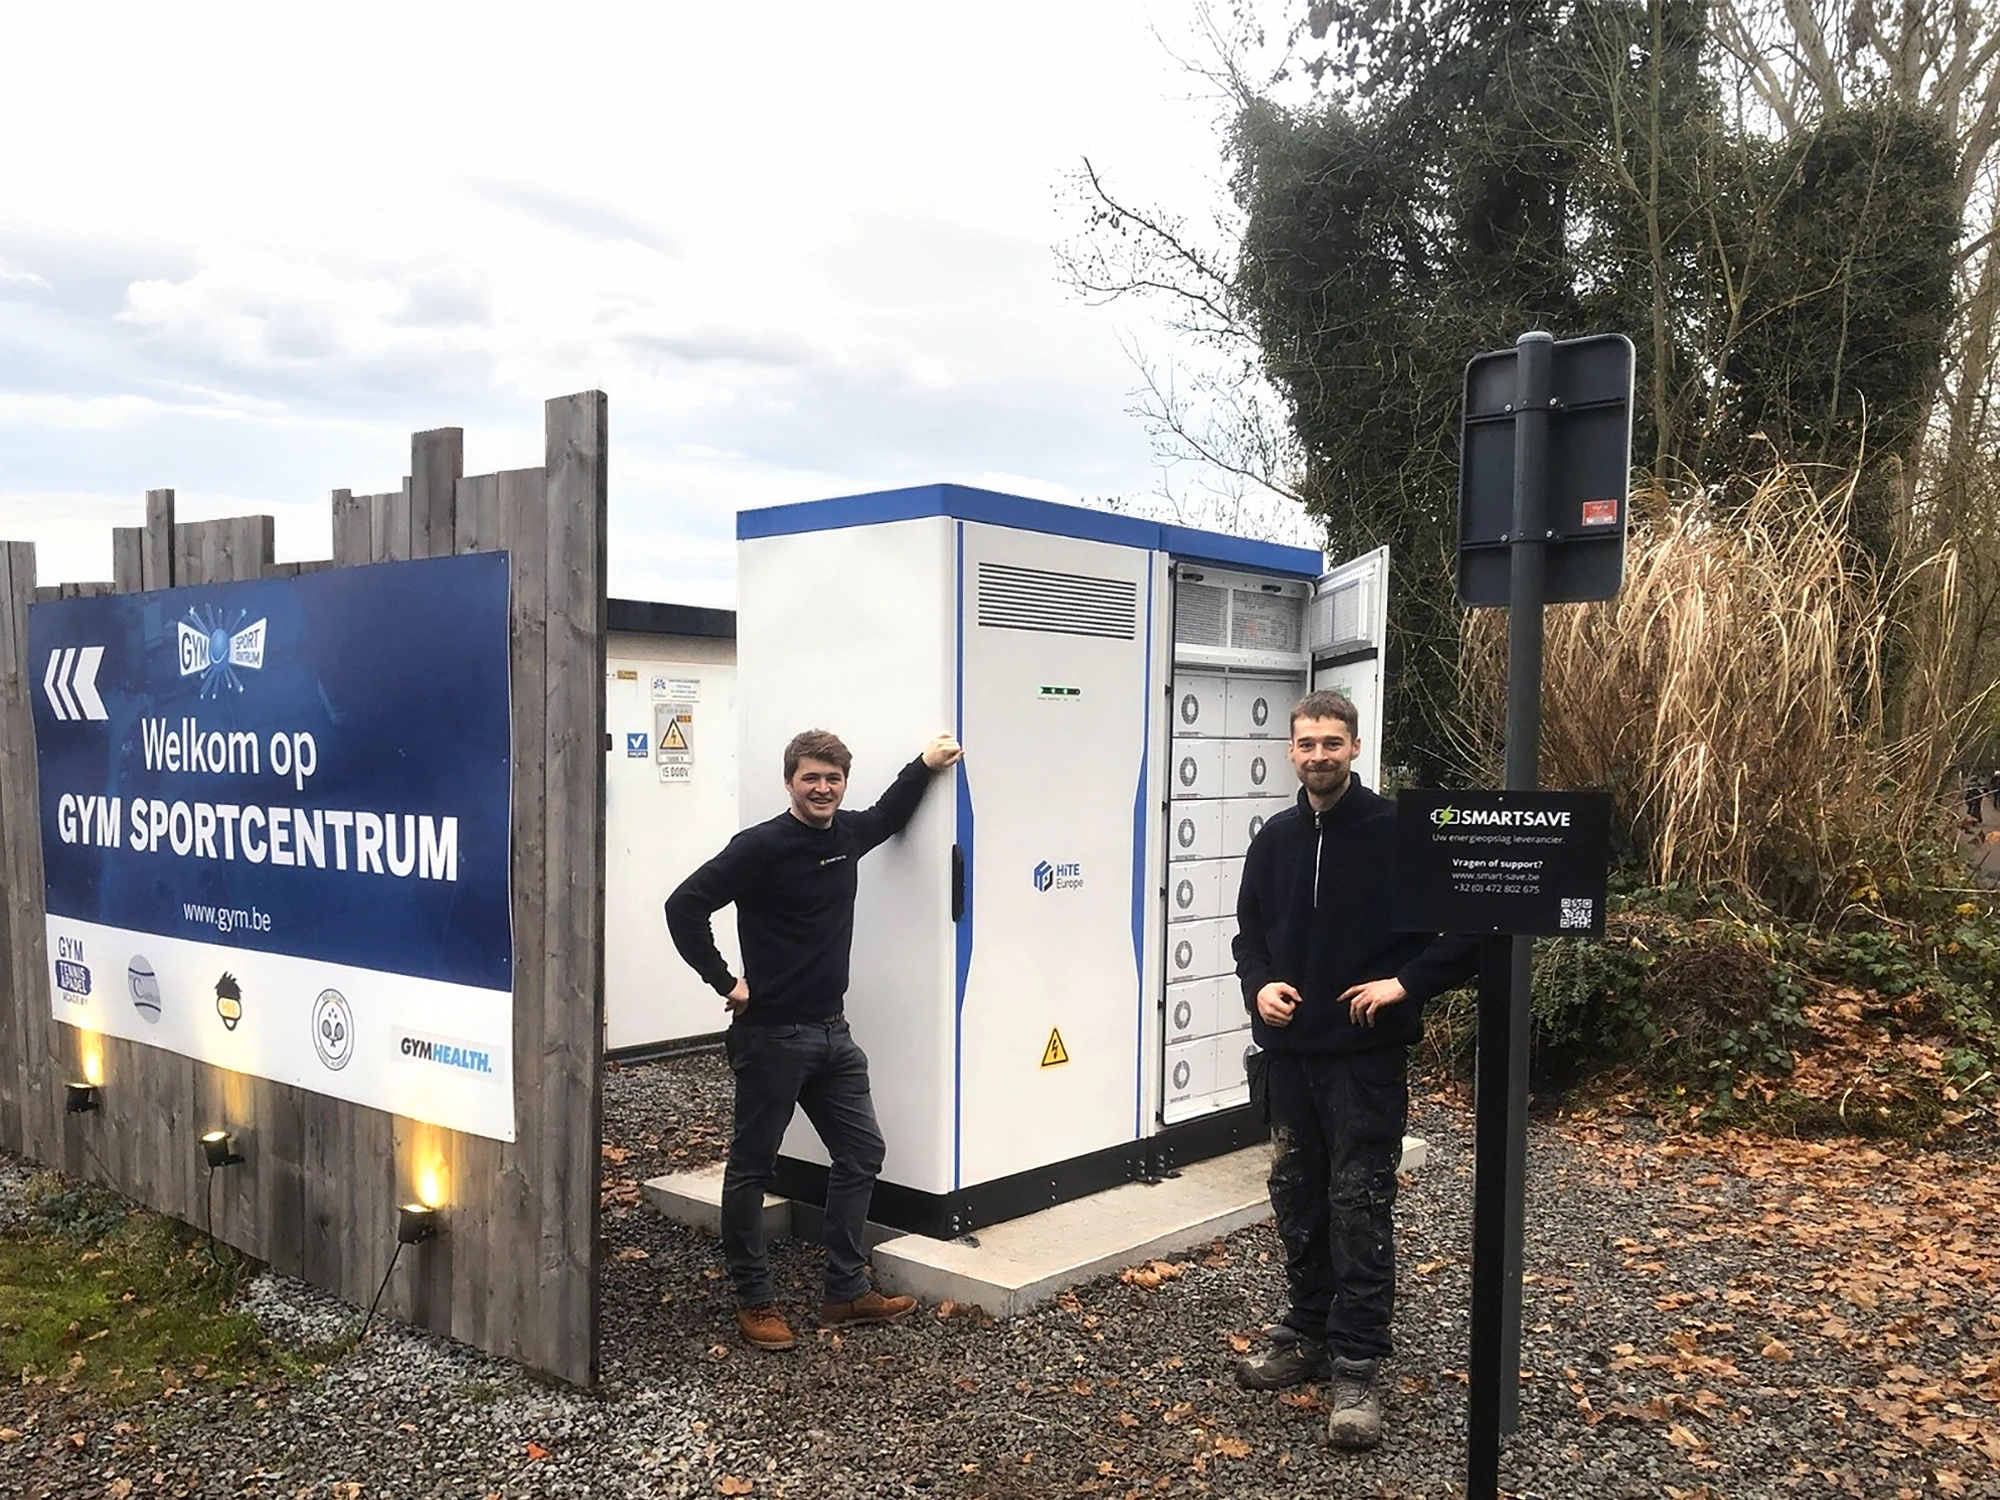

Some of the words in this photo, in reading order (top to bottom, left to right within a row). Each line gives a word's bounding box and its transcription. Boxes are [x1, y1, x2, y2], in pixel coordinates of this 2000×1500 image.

[236, 628, 260, 650] SPORT
[181, 632, 208, 670] GYM
[142, 717, 259, 774] Welkom
[270, 731, 317, 791] op
[1461, 810, 1571, 827] SMARTSAVE
[58, 794, 121, 848] GYM
[129, 797, 459, 881] SPORTCENTRUM
[1432, 833, 1447, 842] Uw
[1449, 834, 1512, 845] energieopslag
[1514, 835, 1566, 844] leverancier.
[1056, 863, 1080, 876] HiTE
[1452, 858, 1487, 869] Vragen
[1488, 859, 1499, 868] of
[1500, 860, 1543, 870] support?
[1056, 878, 1084, 891] Europe
[1452, 873, 1540, 881] www.smart-save.be
[1454, 883, 1470, 892] +32
[1471, 883, 1484, 893] (0)
[1485, 884, 1502, 893] 472
[1504, 884, 1521, 894] 802
[1522, 885, 1540, 895] 675
[183, 903, 271, 932] www.gym.be
[58, 936, 84, 962] GYM
